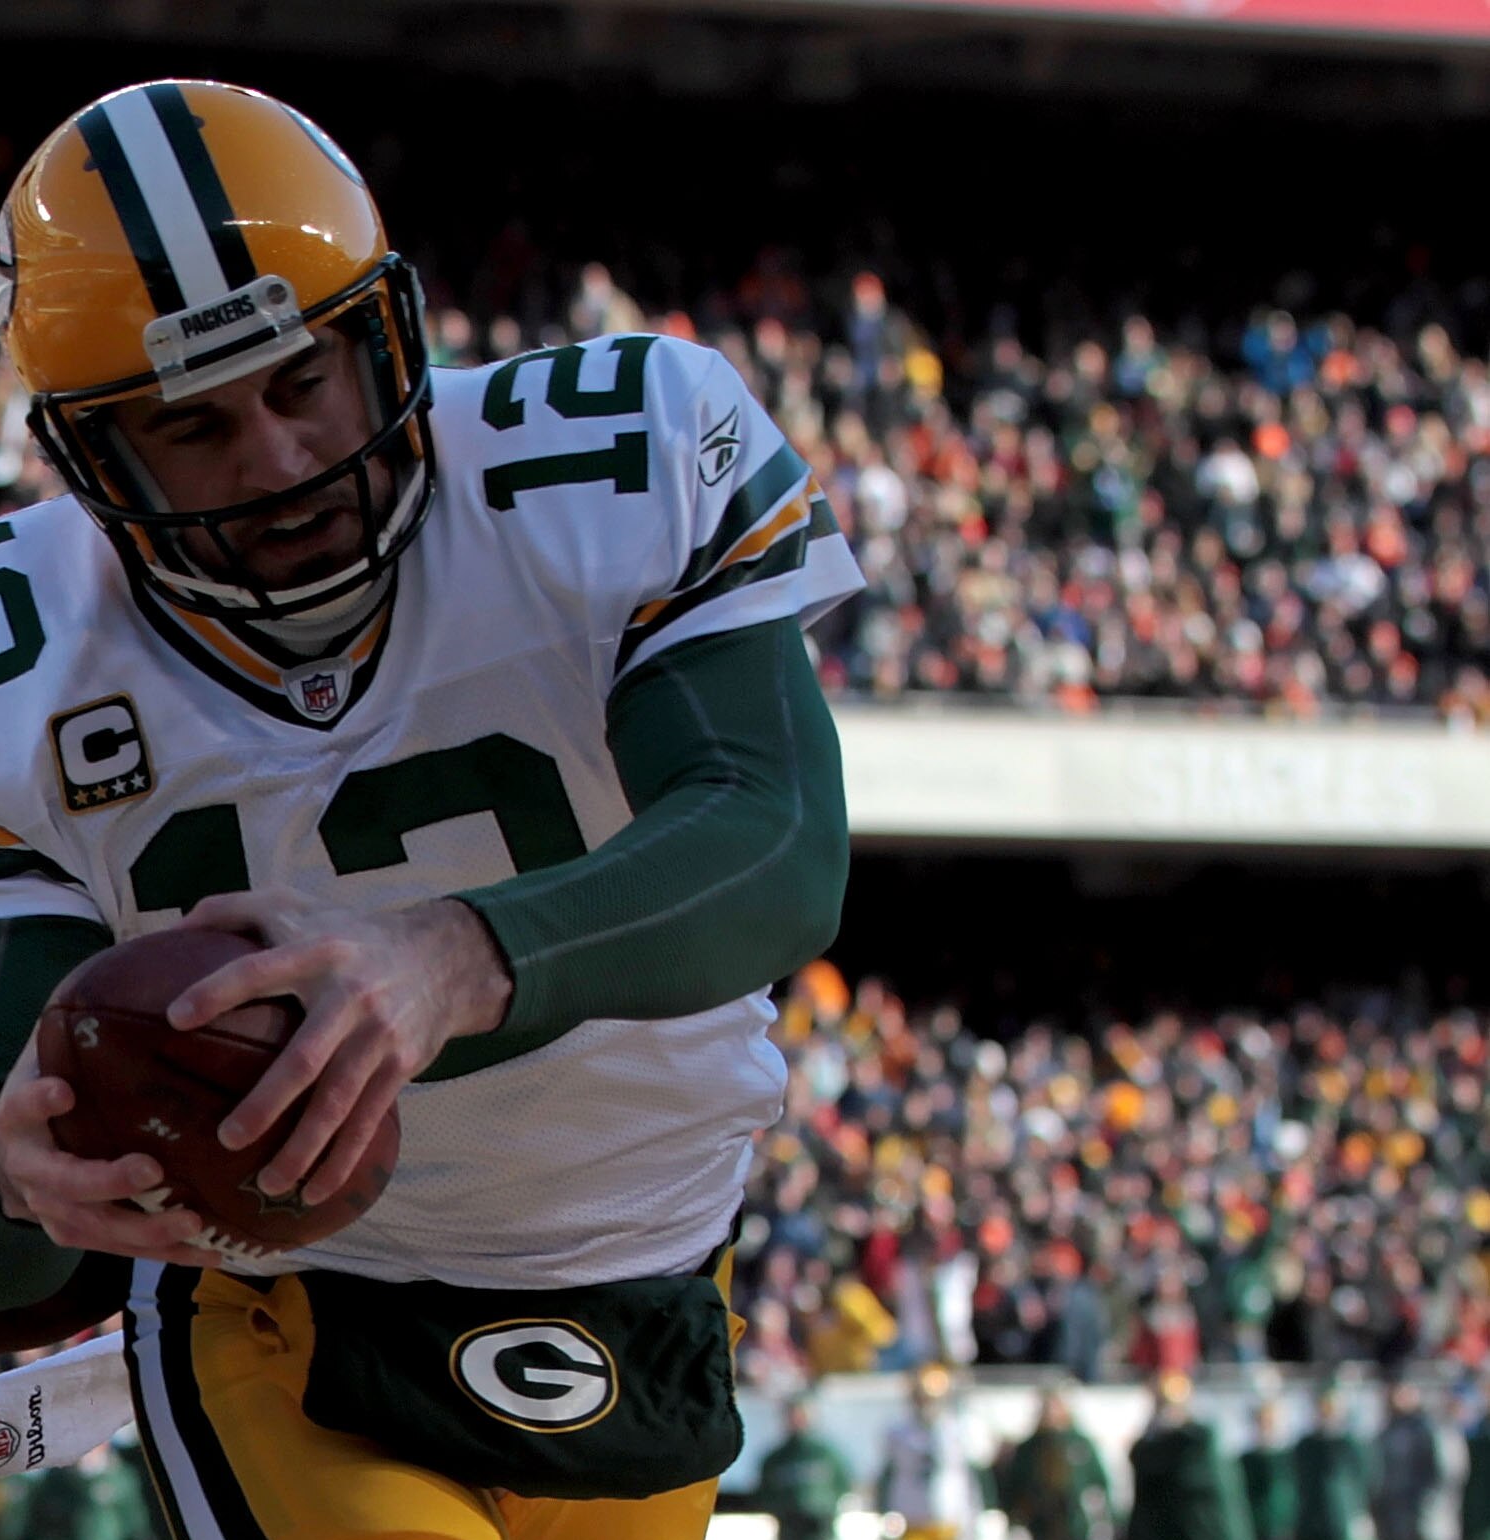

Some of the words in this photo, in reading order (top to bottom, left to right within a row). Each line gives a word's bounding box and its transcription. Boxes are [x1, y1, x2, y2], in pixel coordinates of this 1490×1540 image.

[180, 294, 256, 340] PACKERS
[481, 336, 661, 512] 12
[58, 705, 142, 786] C
[457, 1322, 611, 1424] G
[25, 1384, 46, 1470] Wilson
